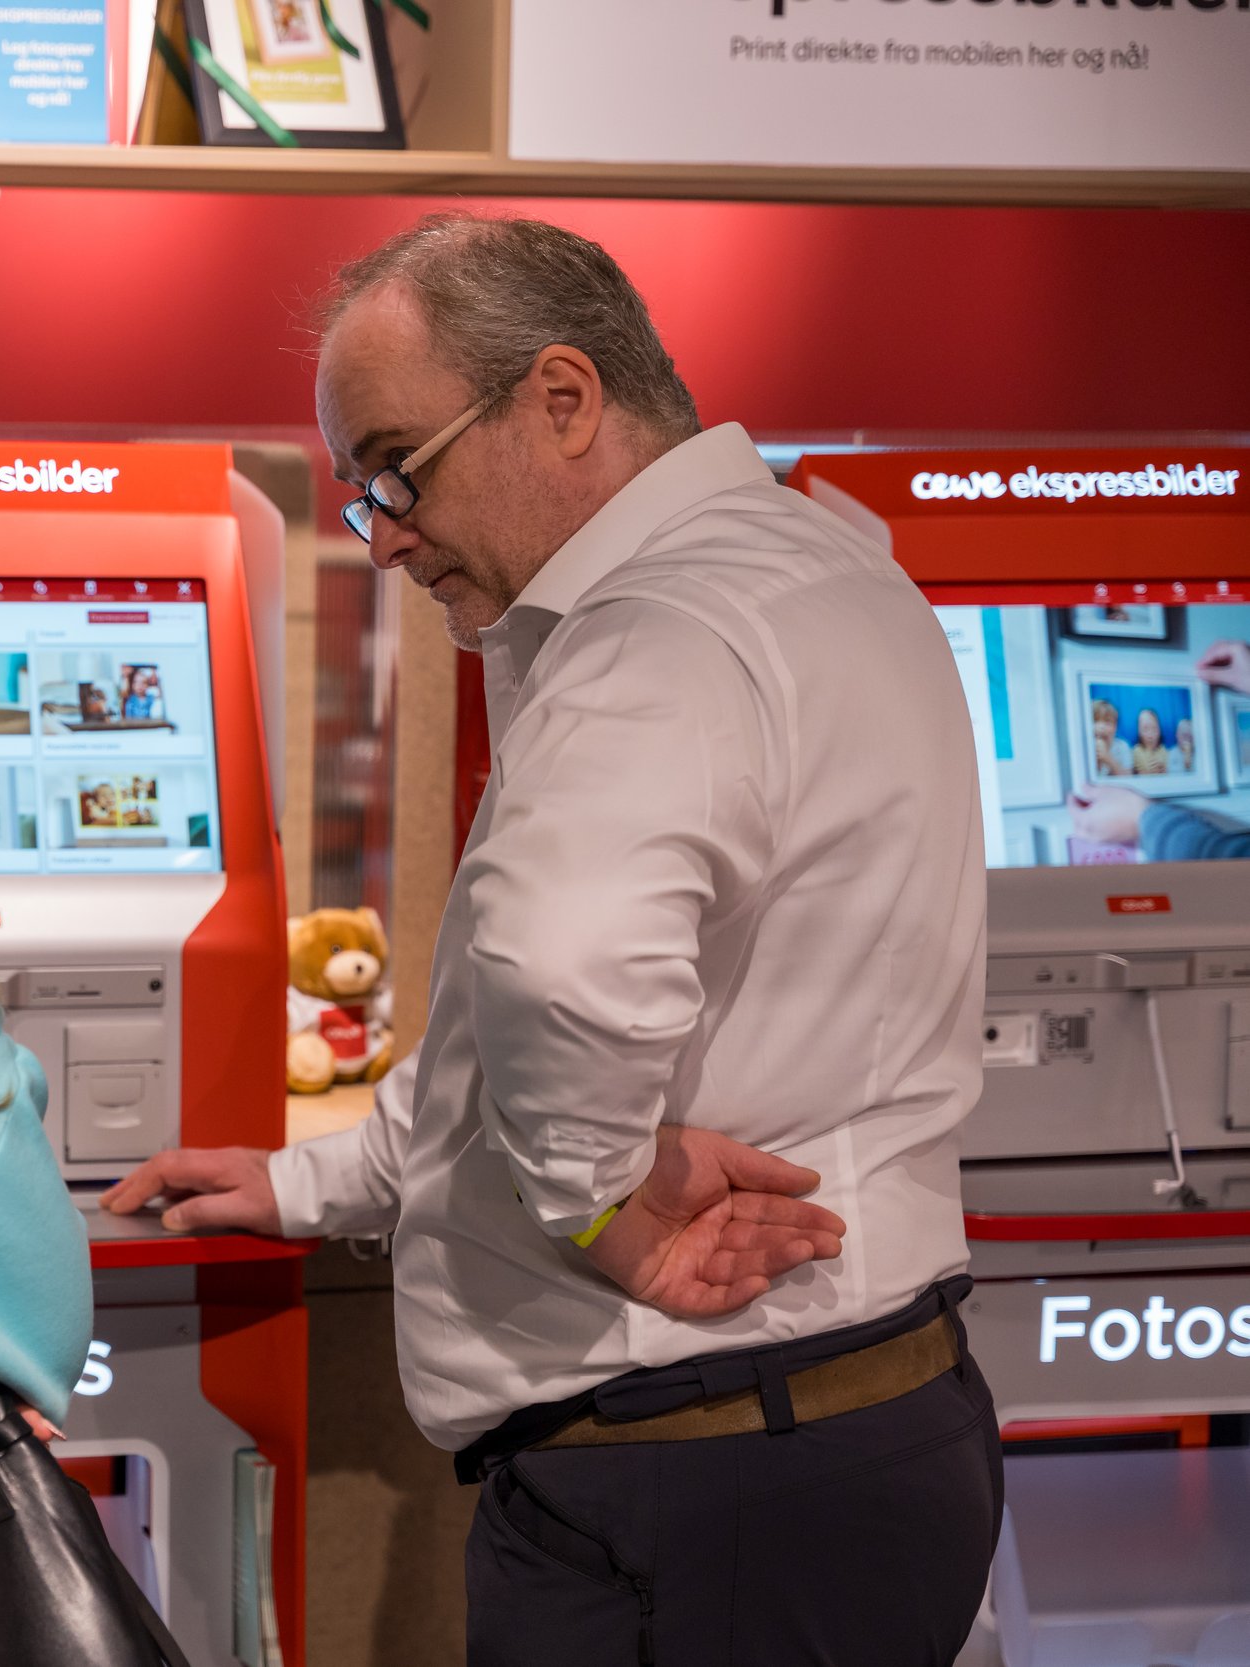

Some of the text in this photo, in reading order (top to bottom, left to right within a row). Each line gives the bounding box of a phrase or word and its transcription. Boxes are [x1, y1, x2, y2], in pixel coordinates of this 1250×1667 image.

[730, 35, 1149, 74] Print direkte fra mobilen her og nå!
[911, 463, 1239, 503] cewe ekspressbilder
